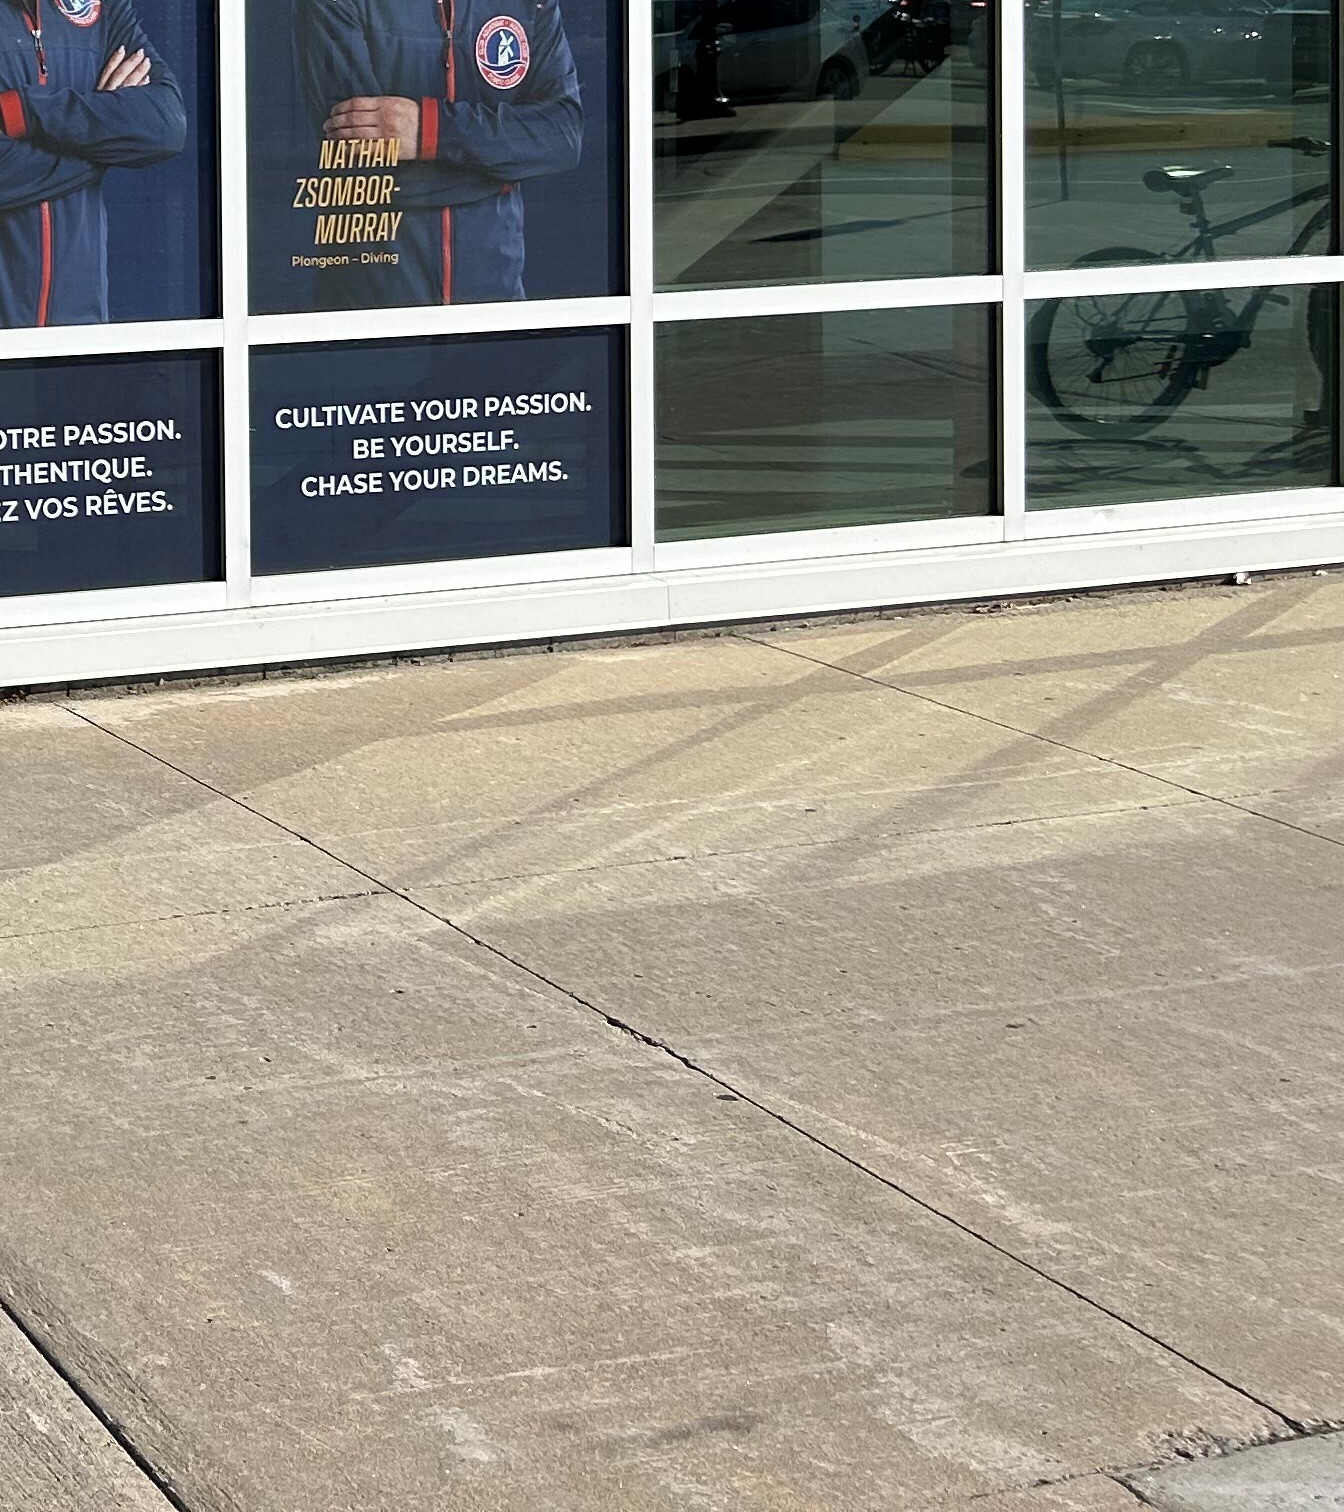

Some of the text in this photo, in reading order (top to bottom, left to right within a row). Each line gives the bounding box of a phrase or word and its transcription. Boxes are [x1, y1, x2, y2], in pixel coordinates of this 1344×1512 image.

[319, 138, 401, 169] NATHAN
[293, 175, 401, 209] ZSOMBOR-
[314, 212, 403, 246] MURRAY
[292, 253, 349, 270] Plongeon
[361, 251, 400, 267] Diving
[275, 391, 592, 430] CULTIVATE YOUR PASSION.
[64, 419, 182, 445] PASSION.
[353, 430, 519, 459] BE YOURSELF.
[301, 460, 569, 498] CHASE YOUR DREAMS.
[25, 496, 78, 519] VOS
[85, 490, 173, 514] RÊVES.
